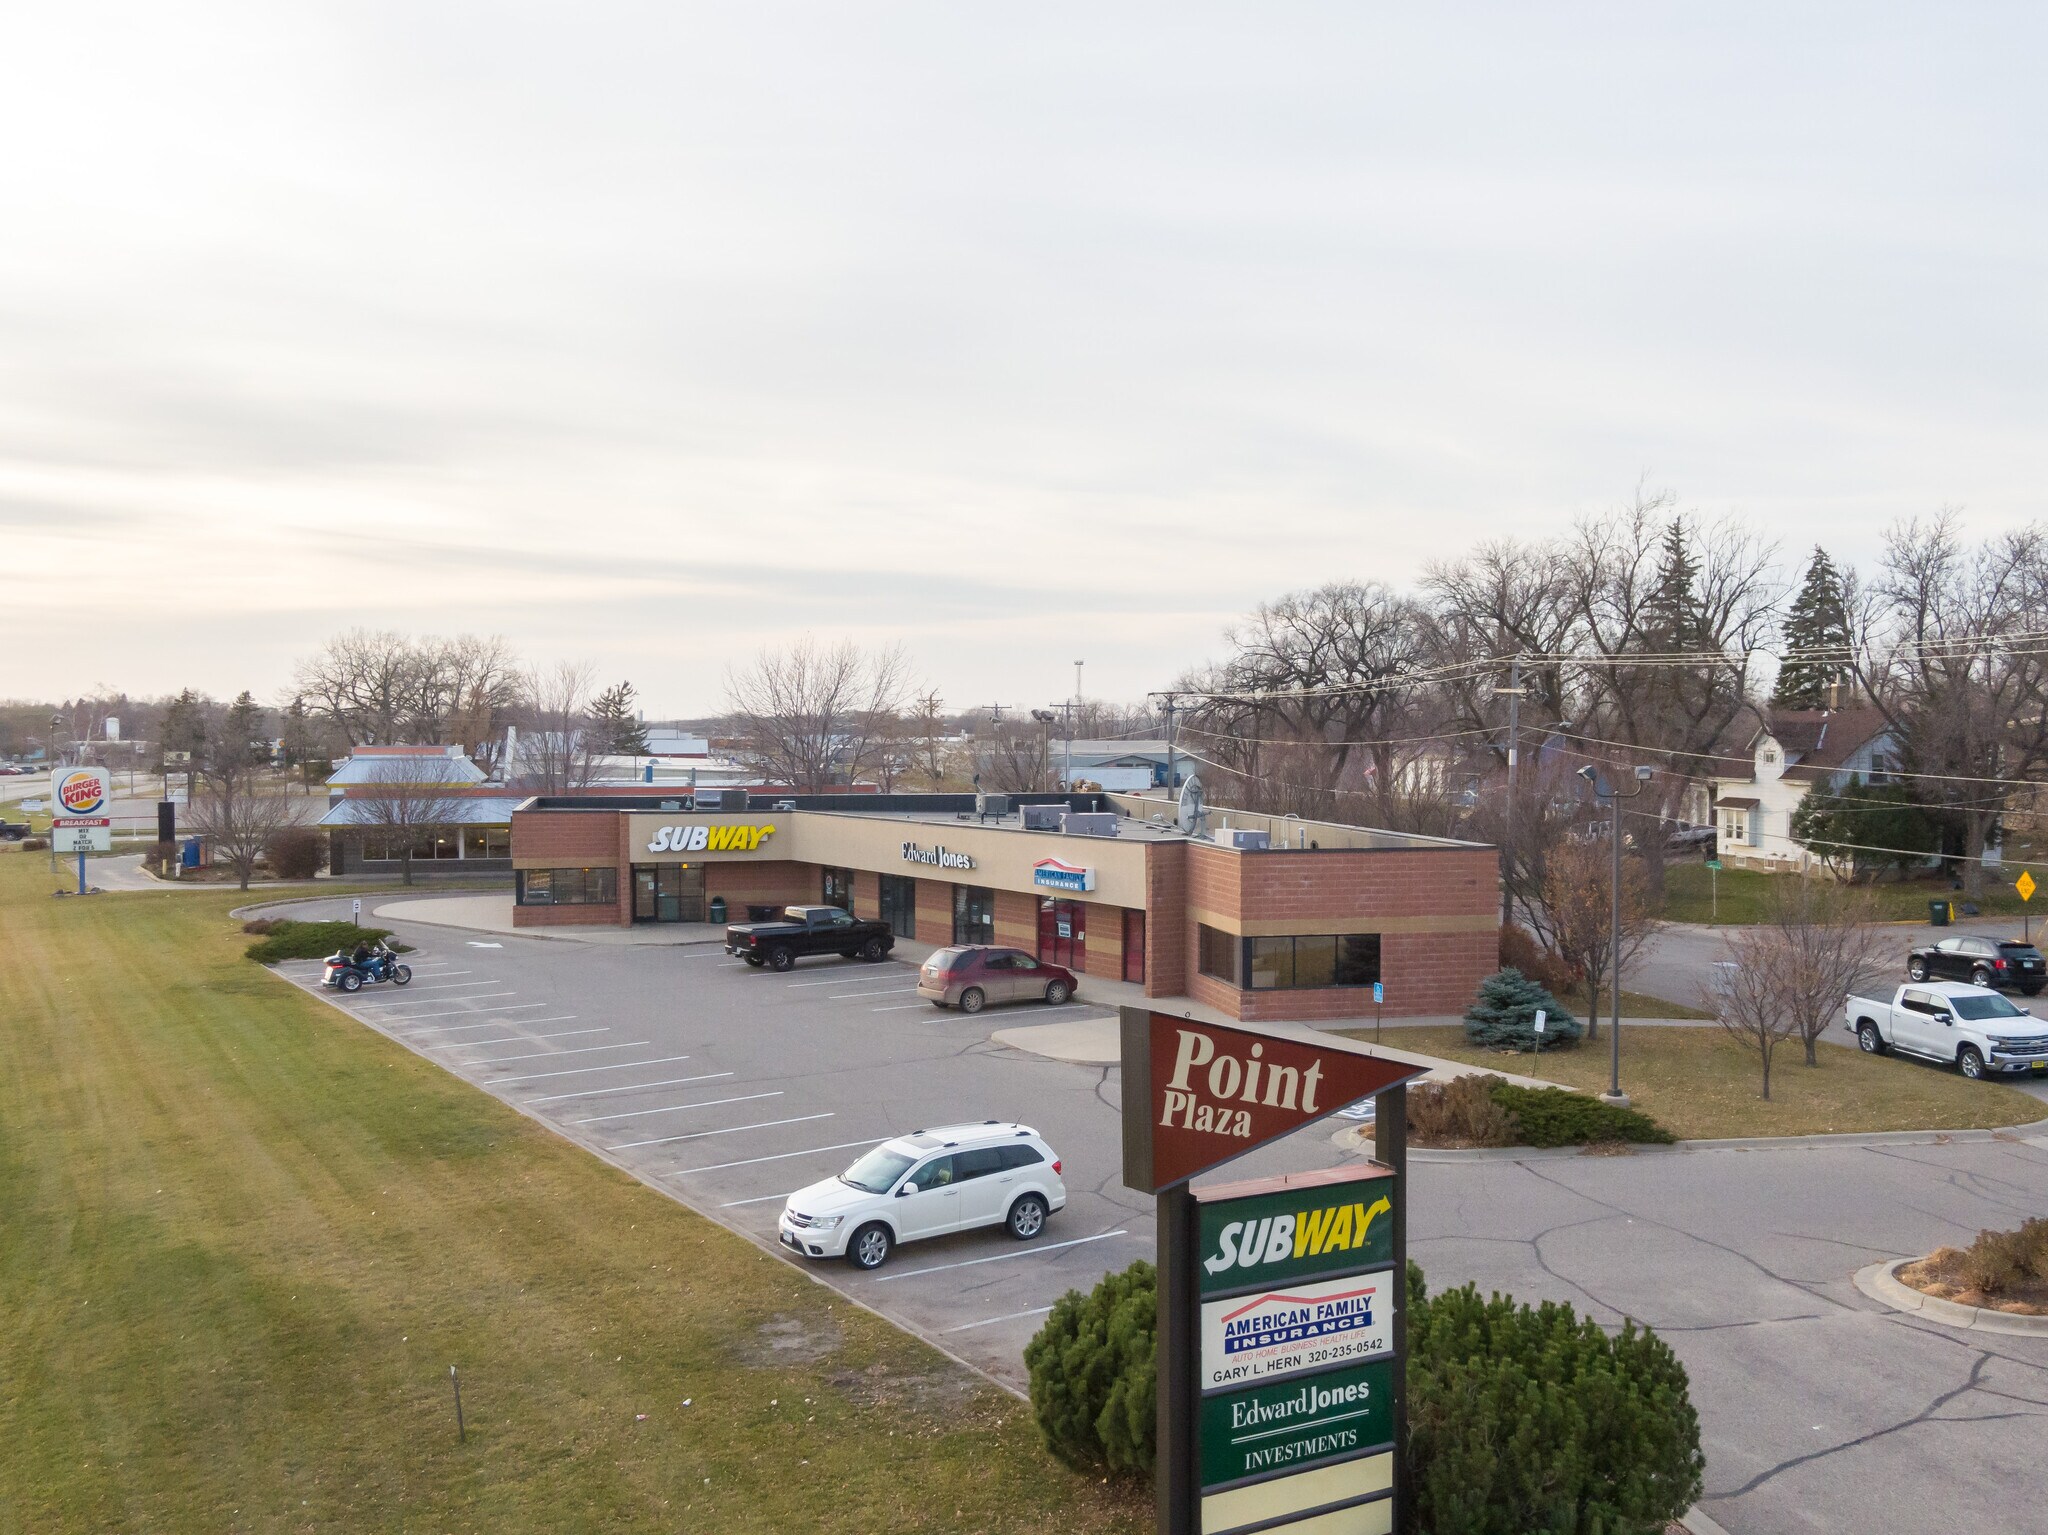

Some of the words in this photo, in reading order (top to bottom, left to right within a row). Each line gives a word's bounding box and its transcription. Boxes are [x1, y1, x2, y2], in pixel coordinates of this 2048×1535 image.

[63, 778, 100, 795] BURGER
[65, 786, 102, 807] KING
[59, 819, 103, 827] BREAKFAST
[647, 824, 776, 853] SUBWAY
[901, 841, 938, 865] Edward
[939, 845, 971, 869] Jones
[1035, 869, 1061, 879] AMERICAN
[1037, 879, 1080, 889] INSURANCE
[1166, 1029, 1324, 1114] Point
[1159, 1090, 1252, 1138] Plaza
[1203, 1195, 1392, 1276] SUBWAY
[1225, 1308, 1310, 1337] AMERICAN
[1317, 1296, 1372, 1320] FAMILY
[1233, 1316, 1365, 1350] INSURANCE
[1213, 1365, 1250, 1383] GARY
[1253, 1364, 1264, 1375] L.
[1267, 1355, 1302, 1372] HERN
[1308, 1338, 1383, 1364] 320-235-0542
[1232, 1352, 1254, 1364] AUTO
[1255, 1347, 1279, 1359] HOME
[1281, 1340, 1318, 1354] BUSINESS
[1320, 1333, 1348, 1347] HEALTH
[1350, 1329, 1366, 1341] LIFE
[1245, 1429, 1357, 1470] INVESTMENTS
